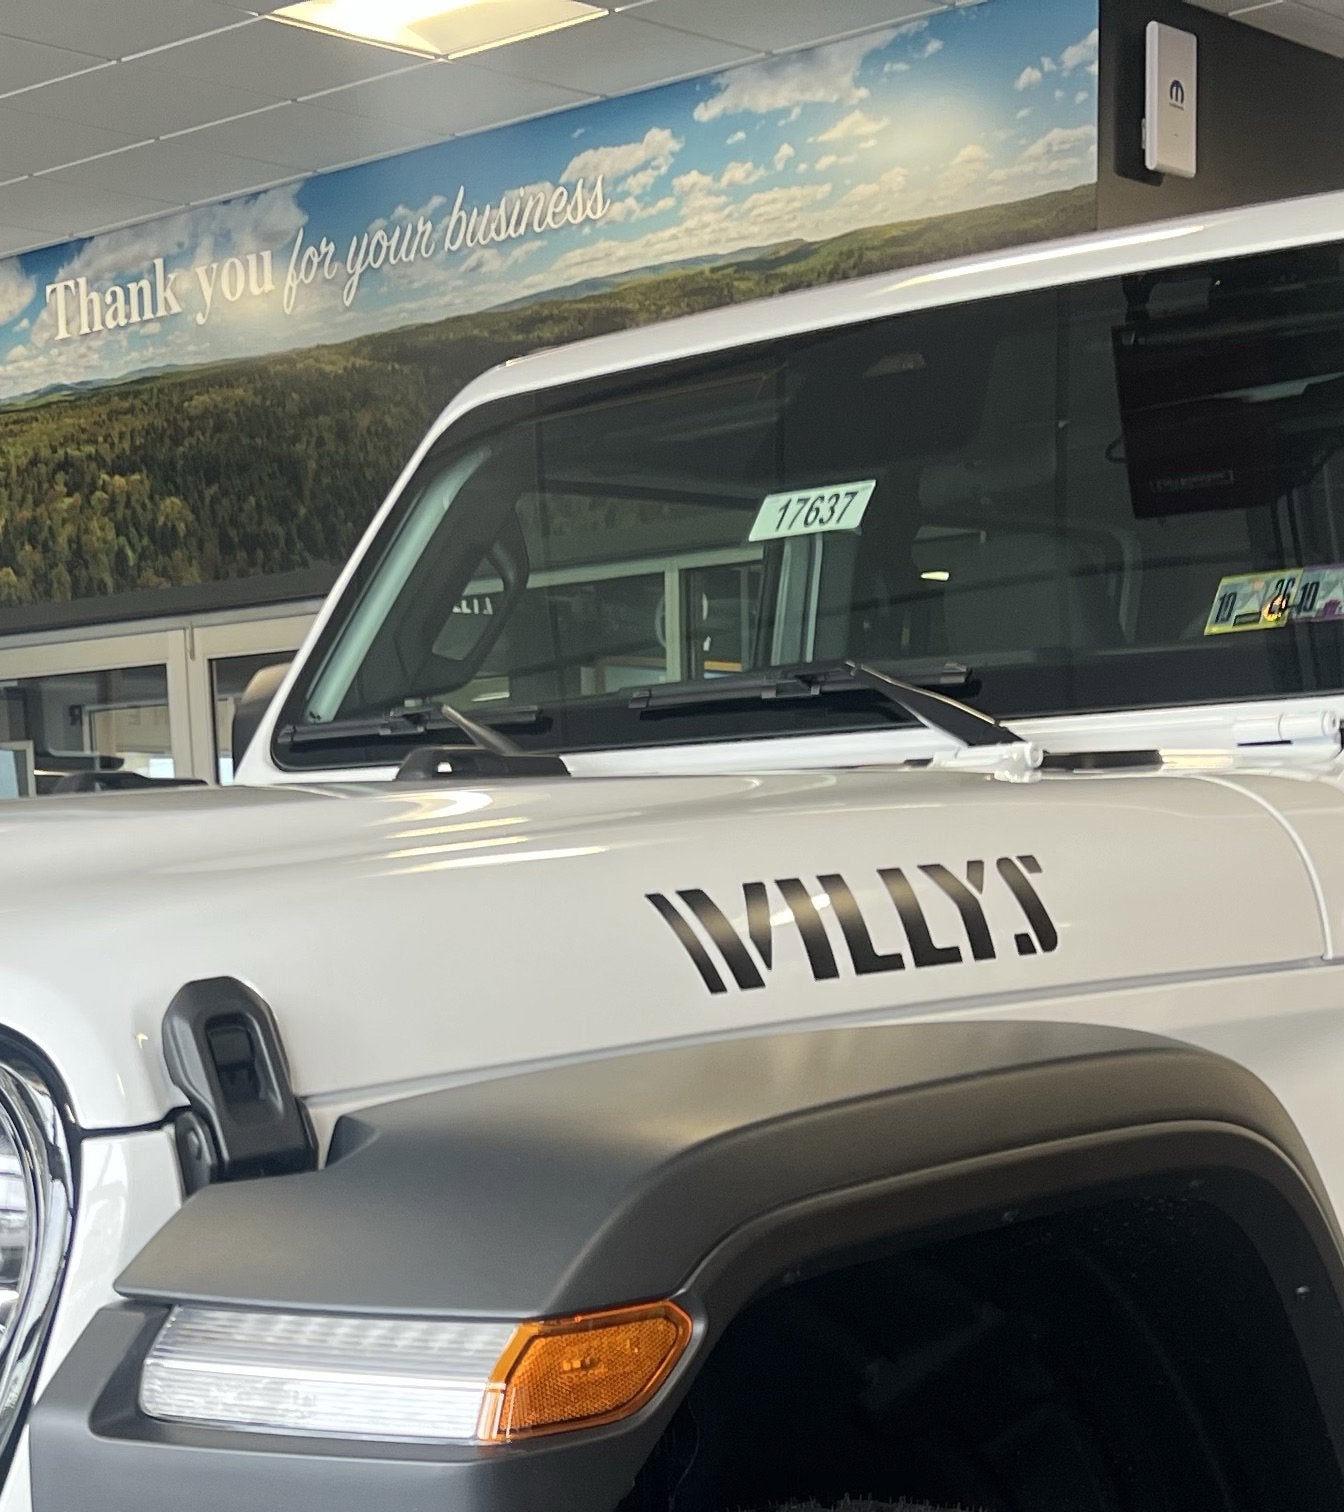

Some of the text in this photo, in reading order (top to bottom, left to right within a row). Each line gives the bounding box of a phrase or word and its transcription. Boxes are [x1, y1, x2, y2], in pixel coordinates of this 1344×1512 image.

[46, 175, 611, 341] Thank you for your business
[775, 491, 859, 532] 17637
[1295, 581, 1320, 614] 10
[645, 855, 1058, 994] WILLYS
